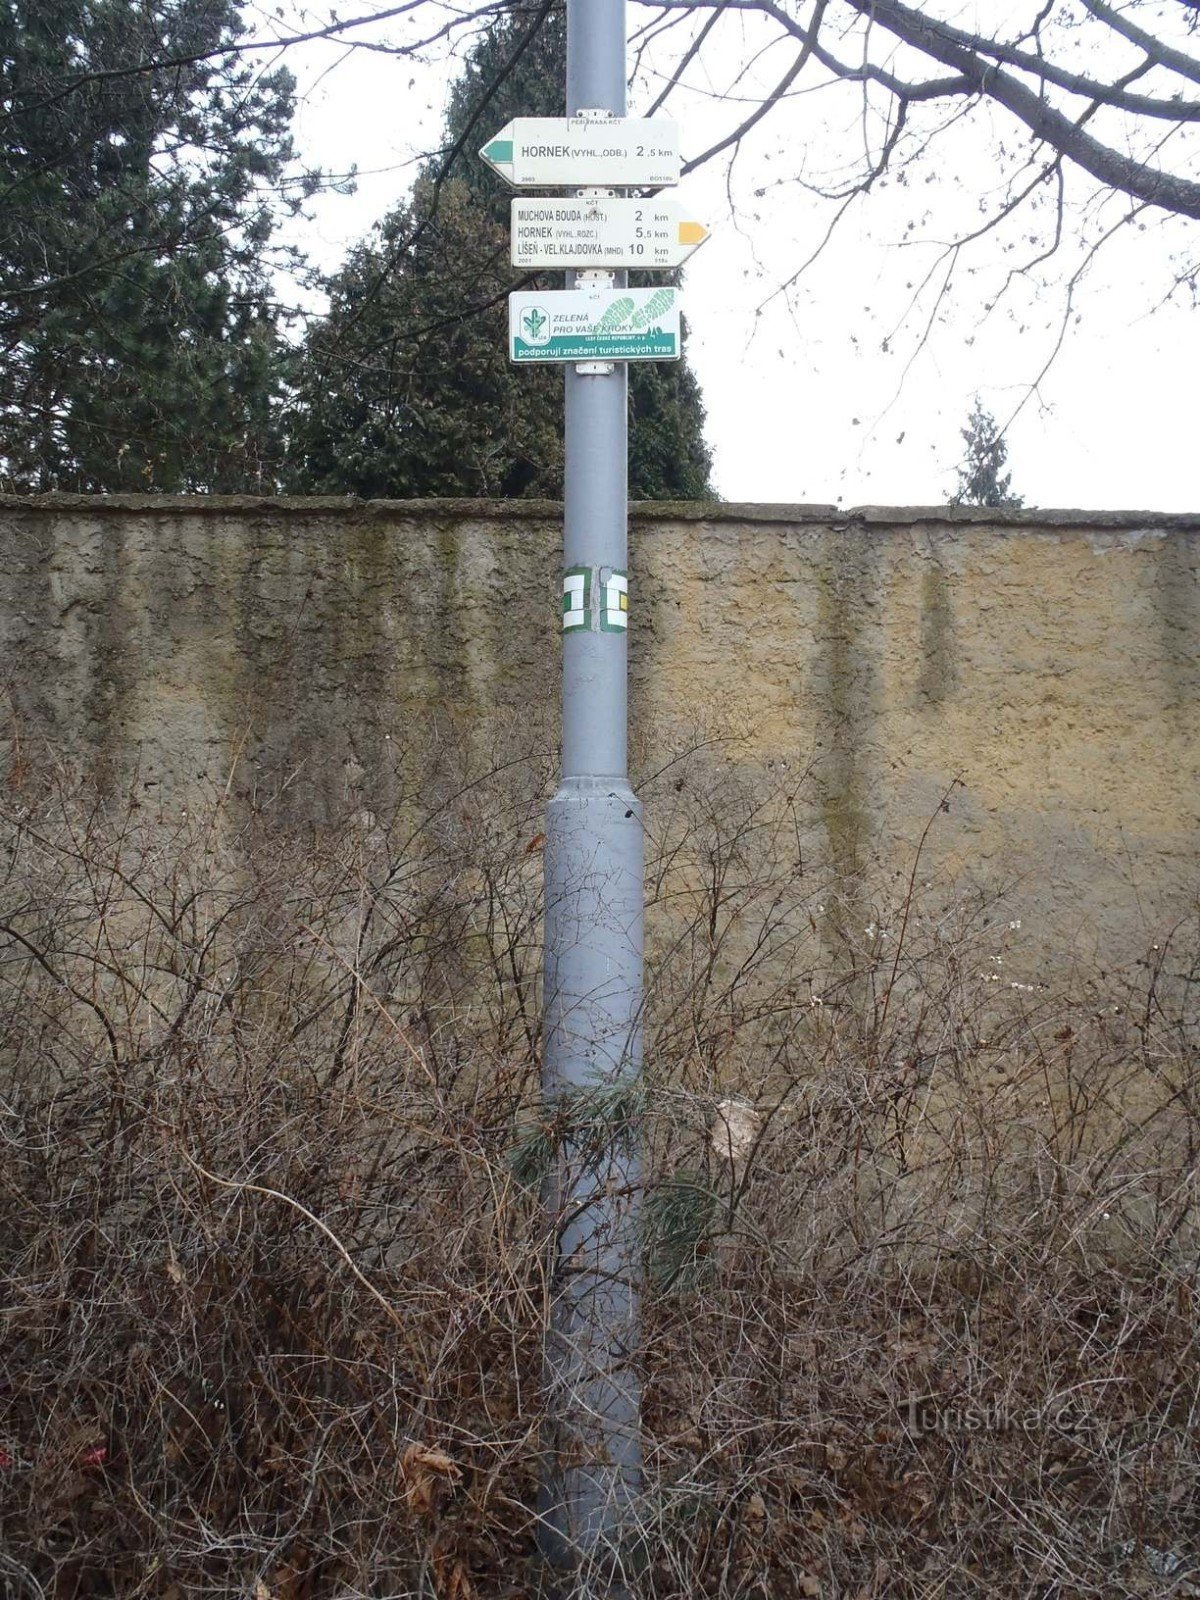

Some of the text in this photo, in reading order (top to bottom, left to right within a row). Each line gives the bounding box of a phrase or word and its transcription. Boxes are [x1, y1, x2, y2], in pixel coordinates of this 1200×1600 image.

[521, 146, 570, 158] HORNEK
[658, 149, 673, 157] km
[518, 210, 554, 222] MUCHOVA
[556, 210, 581, 222] BOUDA
[635, 211, 669, 222] 2 km
[518, 227, 553, 238] HORNEK
[654, 230, 669, 238] km
[629, 244, 669, 255] 10 km
[553, 313, 589, 322] ZELENÁ
[553, 323, 635, 334] PRO VAŠE KROKY
[518, 345, 672, 357] podporují značení turistických tras
